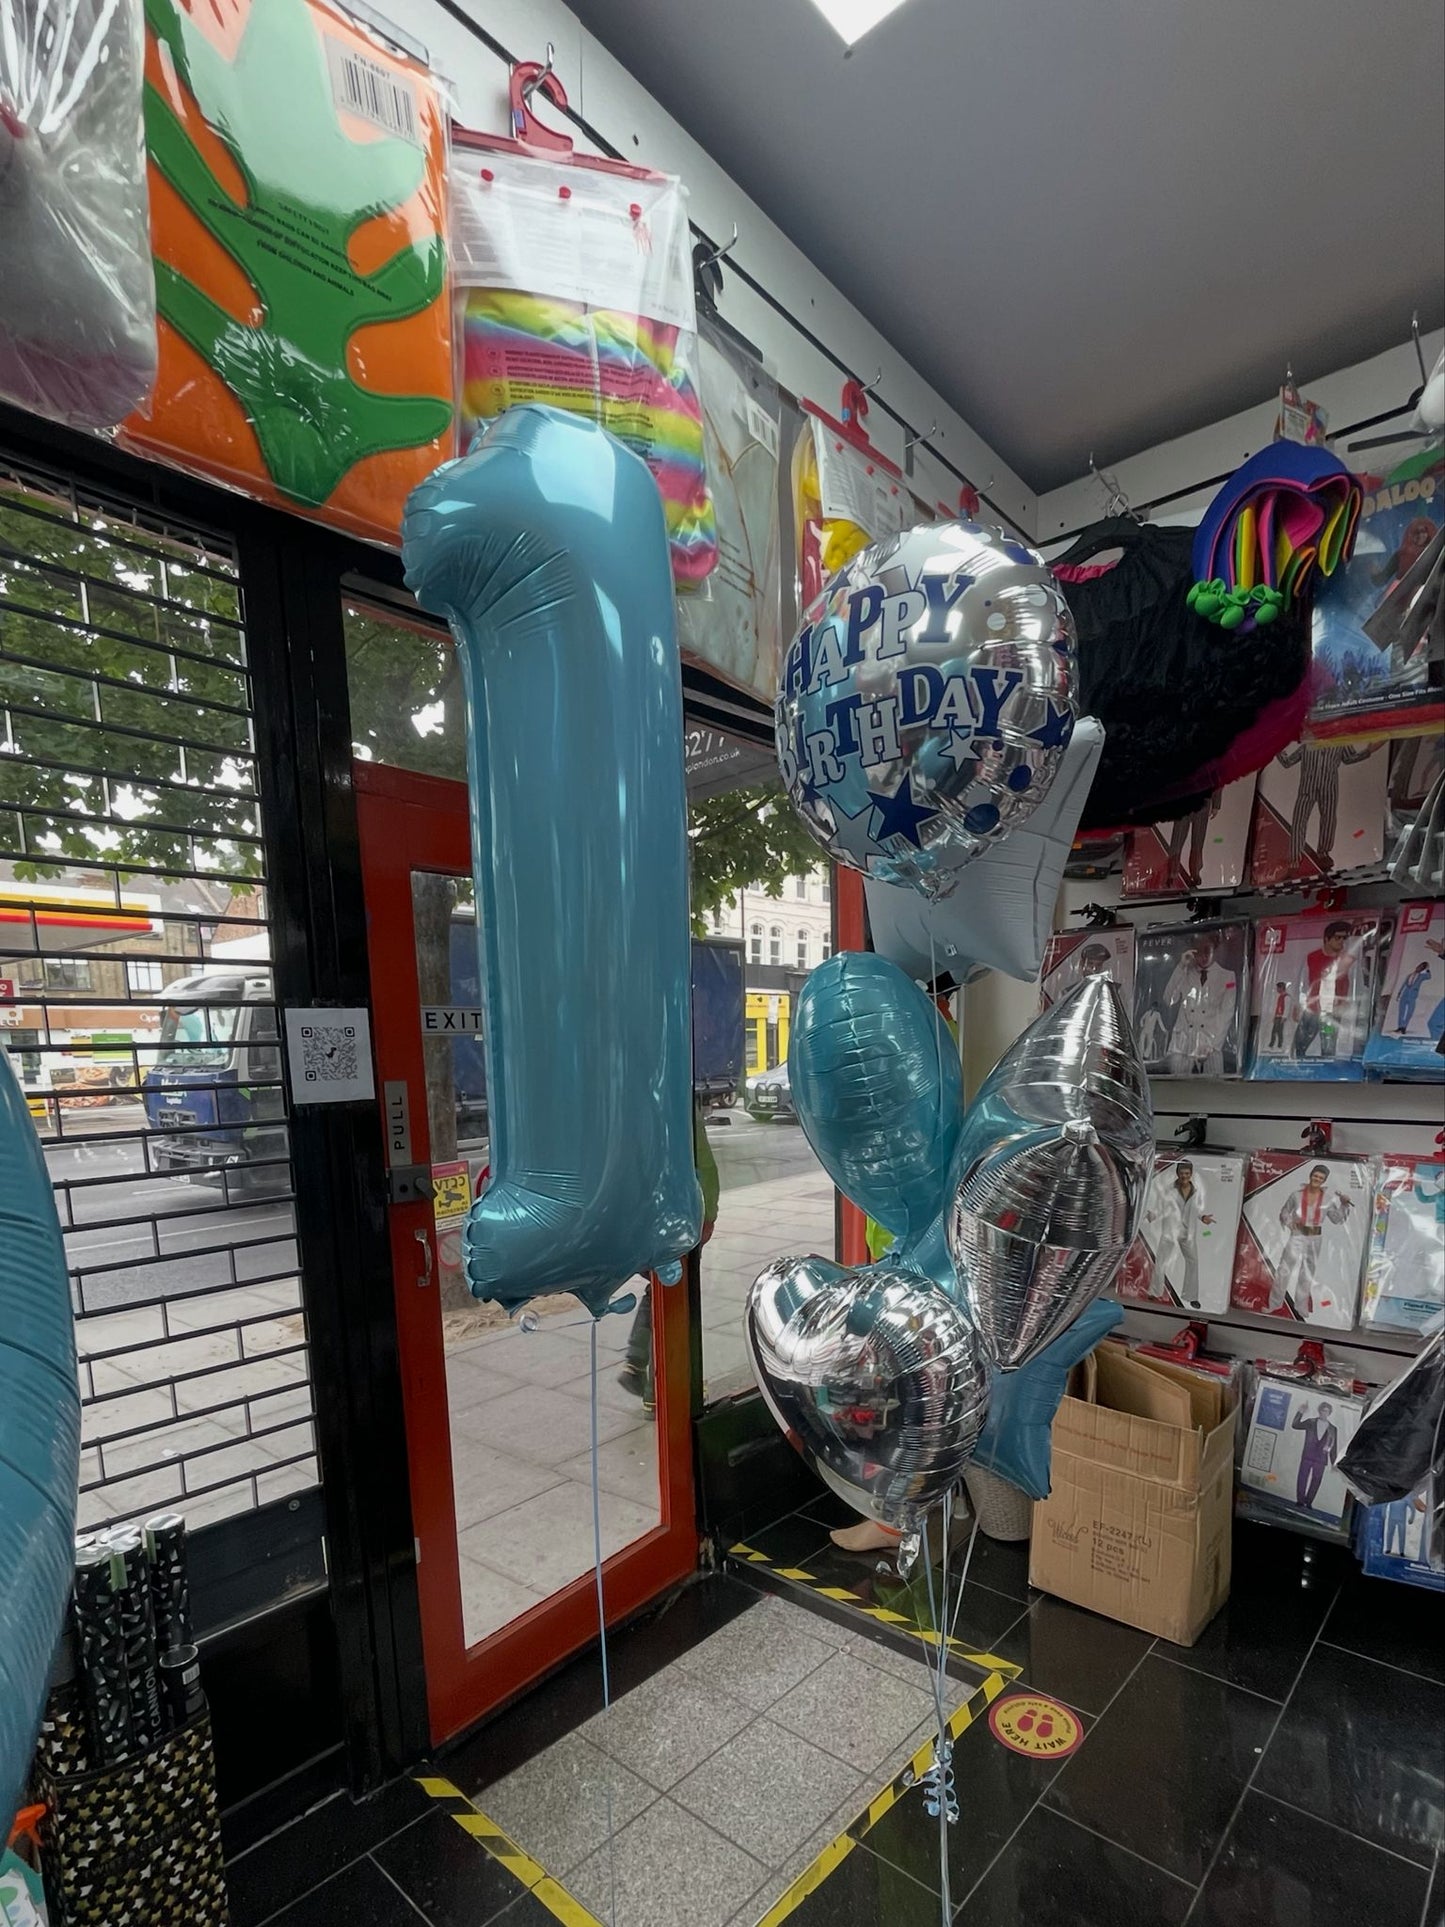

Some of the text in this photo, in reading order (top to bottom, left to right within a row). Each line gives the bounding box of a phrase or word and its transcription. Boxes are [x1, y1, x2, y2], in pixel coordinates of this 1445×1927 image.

[784, 573, 975, 699] HAPPY
[776, 664, 1025, 787] BIRTHDAY
[1143, 938, 1173, 947] FEVER
[425, 1012, 482, 1029] EXIT
[391, 1096, 405, 1150] PULL
[1093, 1538, 1103, 1549] 12
[1106, 1543, 1125, 1556] pcs
[144, 1665, 161, 1727] CANNON
[1002, 1722, 1067, 1750] WAIT HERE
